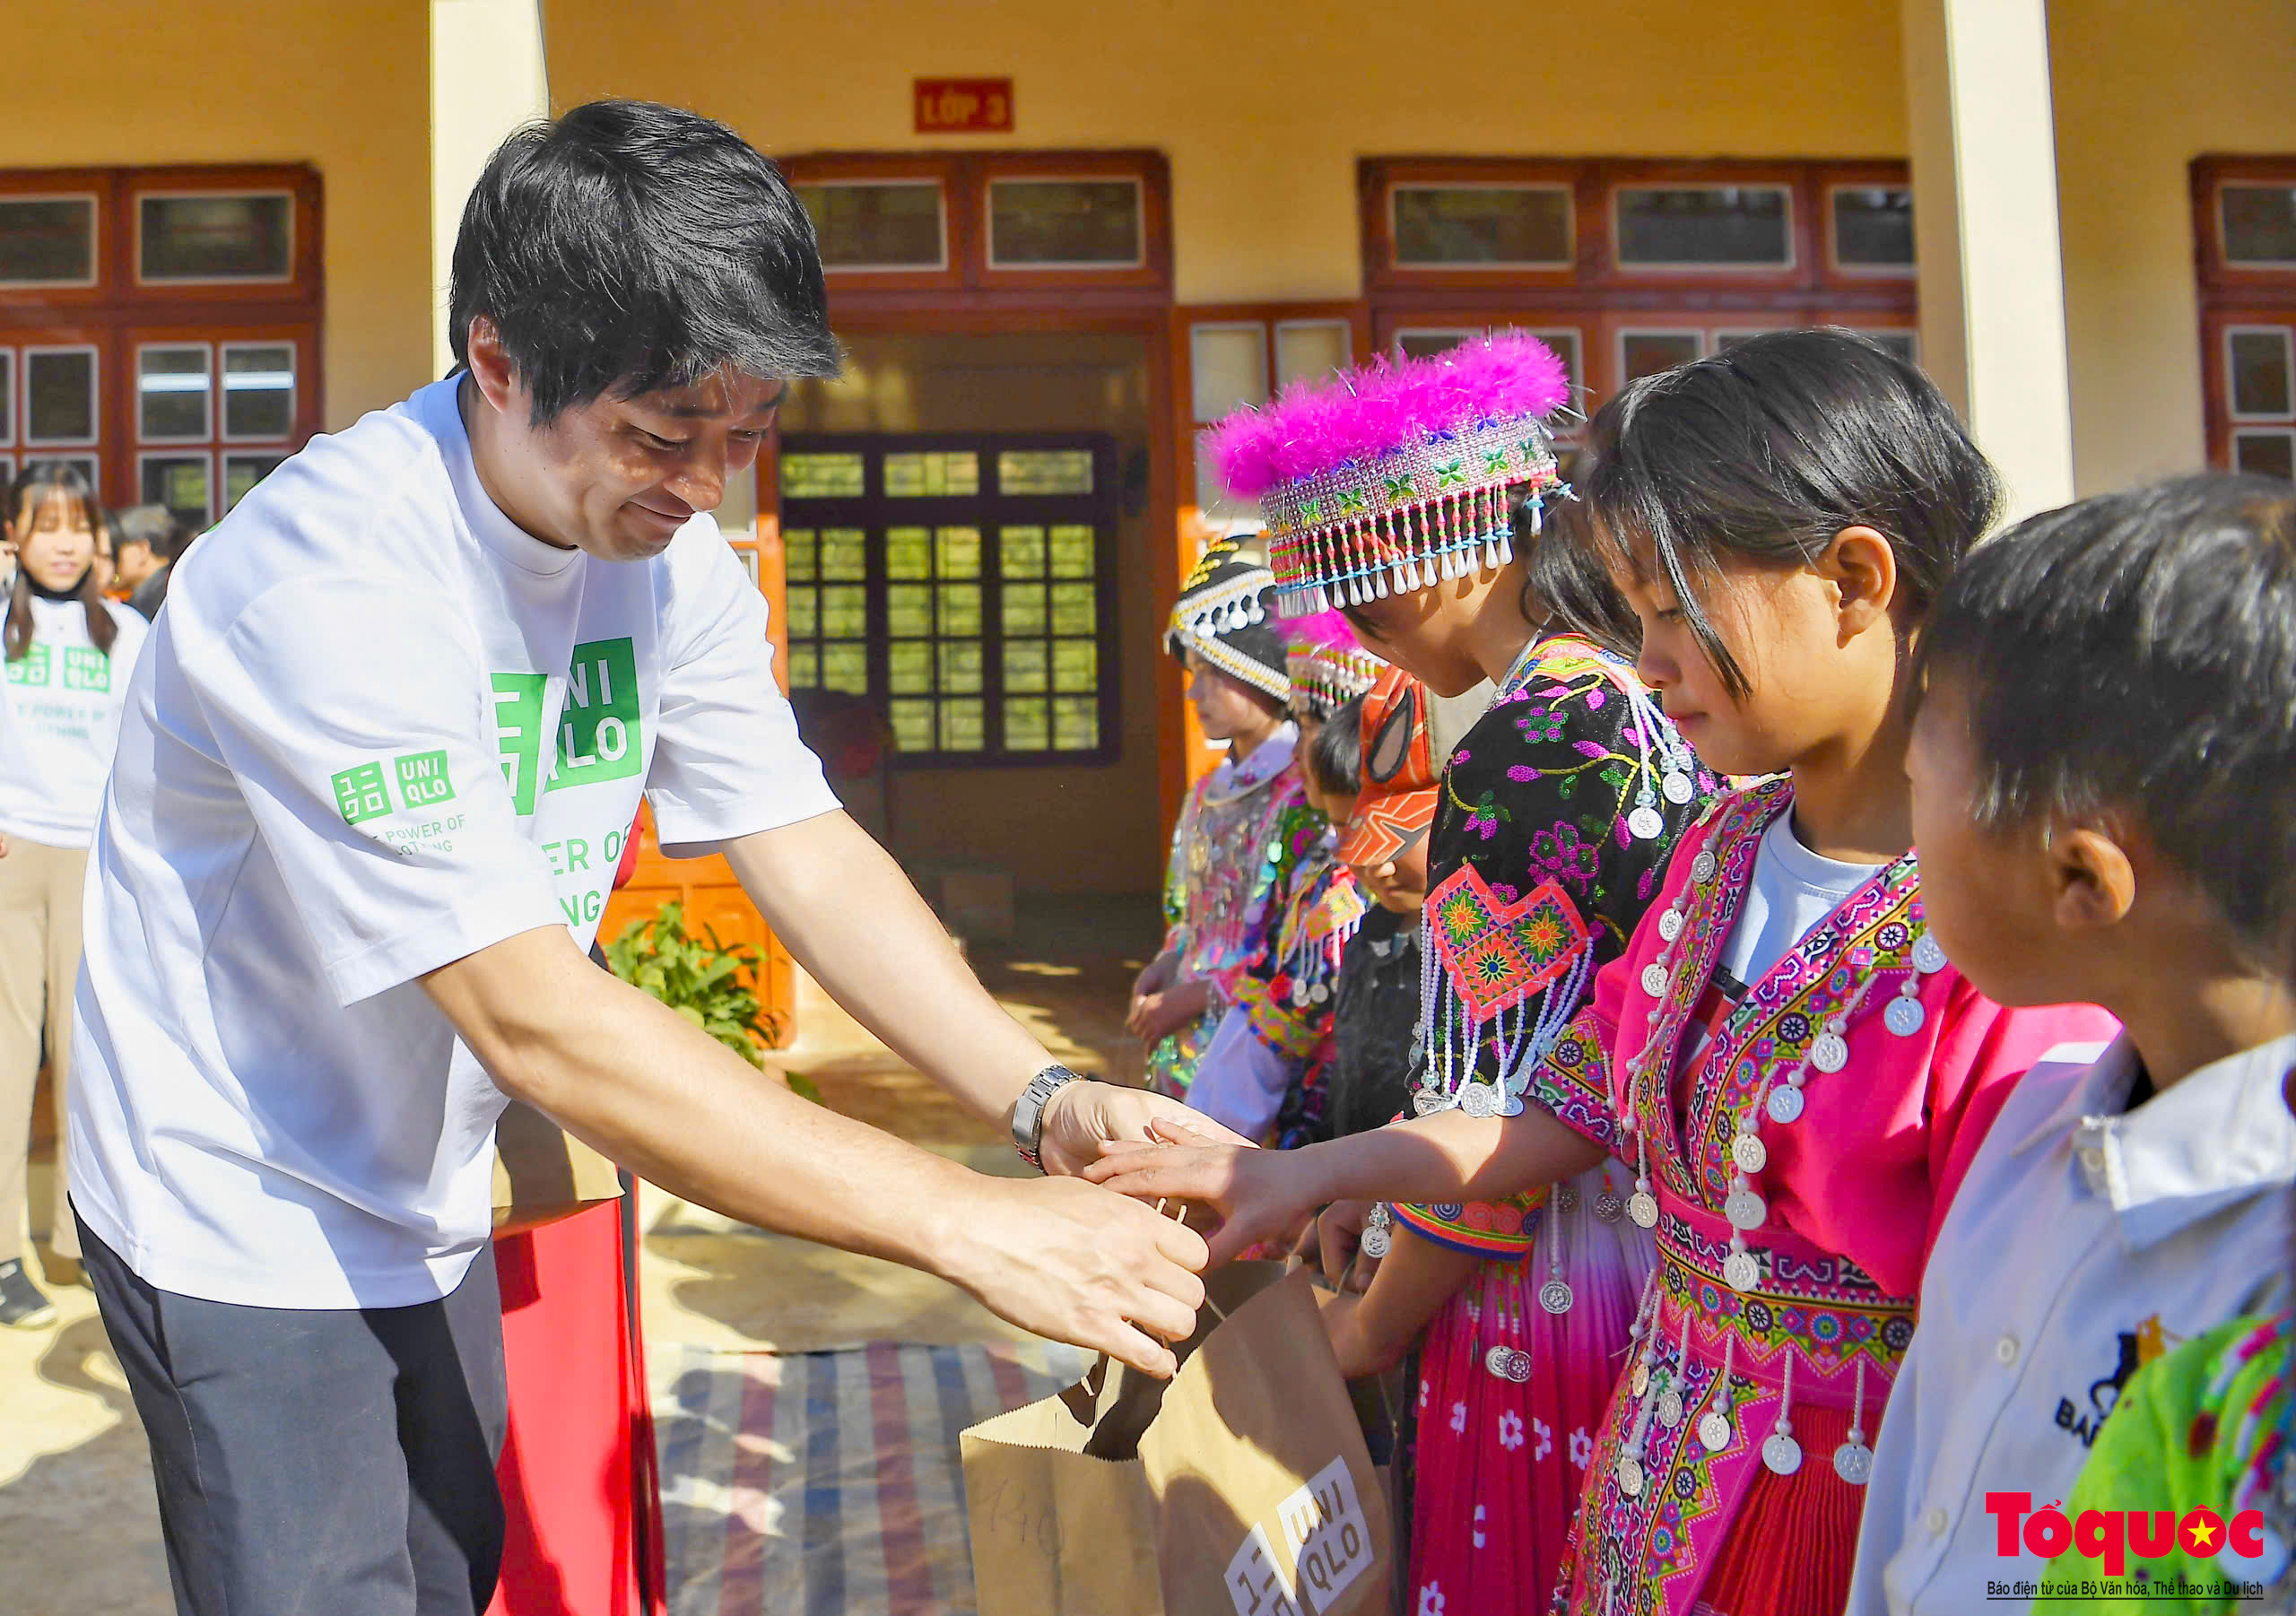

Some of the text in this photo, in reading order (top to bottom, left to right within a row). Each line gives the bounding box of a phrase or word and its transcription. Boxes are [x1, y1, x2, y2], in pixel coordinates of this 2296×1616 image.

[987, 93, 1006, 125] 3
[563, 656, 613, 711] NI
[401, 757, 439, 781] UNI
[405, 778, 448, 804] QLO
[385, 813, 465, 842] POWER OF
[1291, 1480, 1344, 1546] UNI
[1306, 1522, 1361, 1593] QLO
